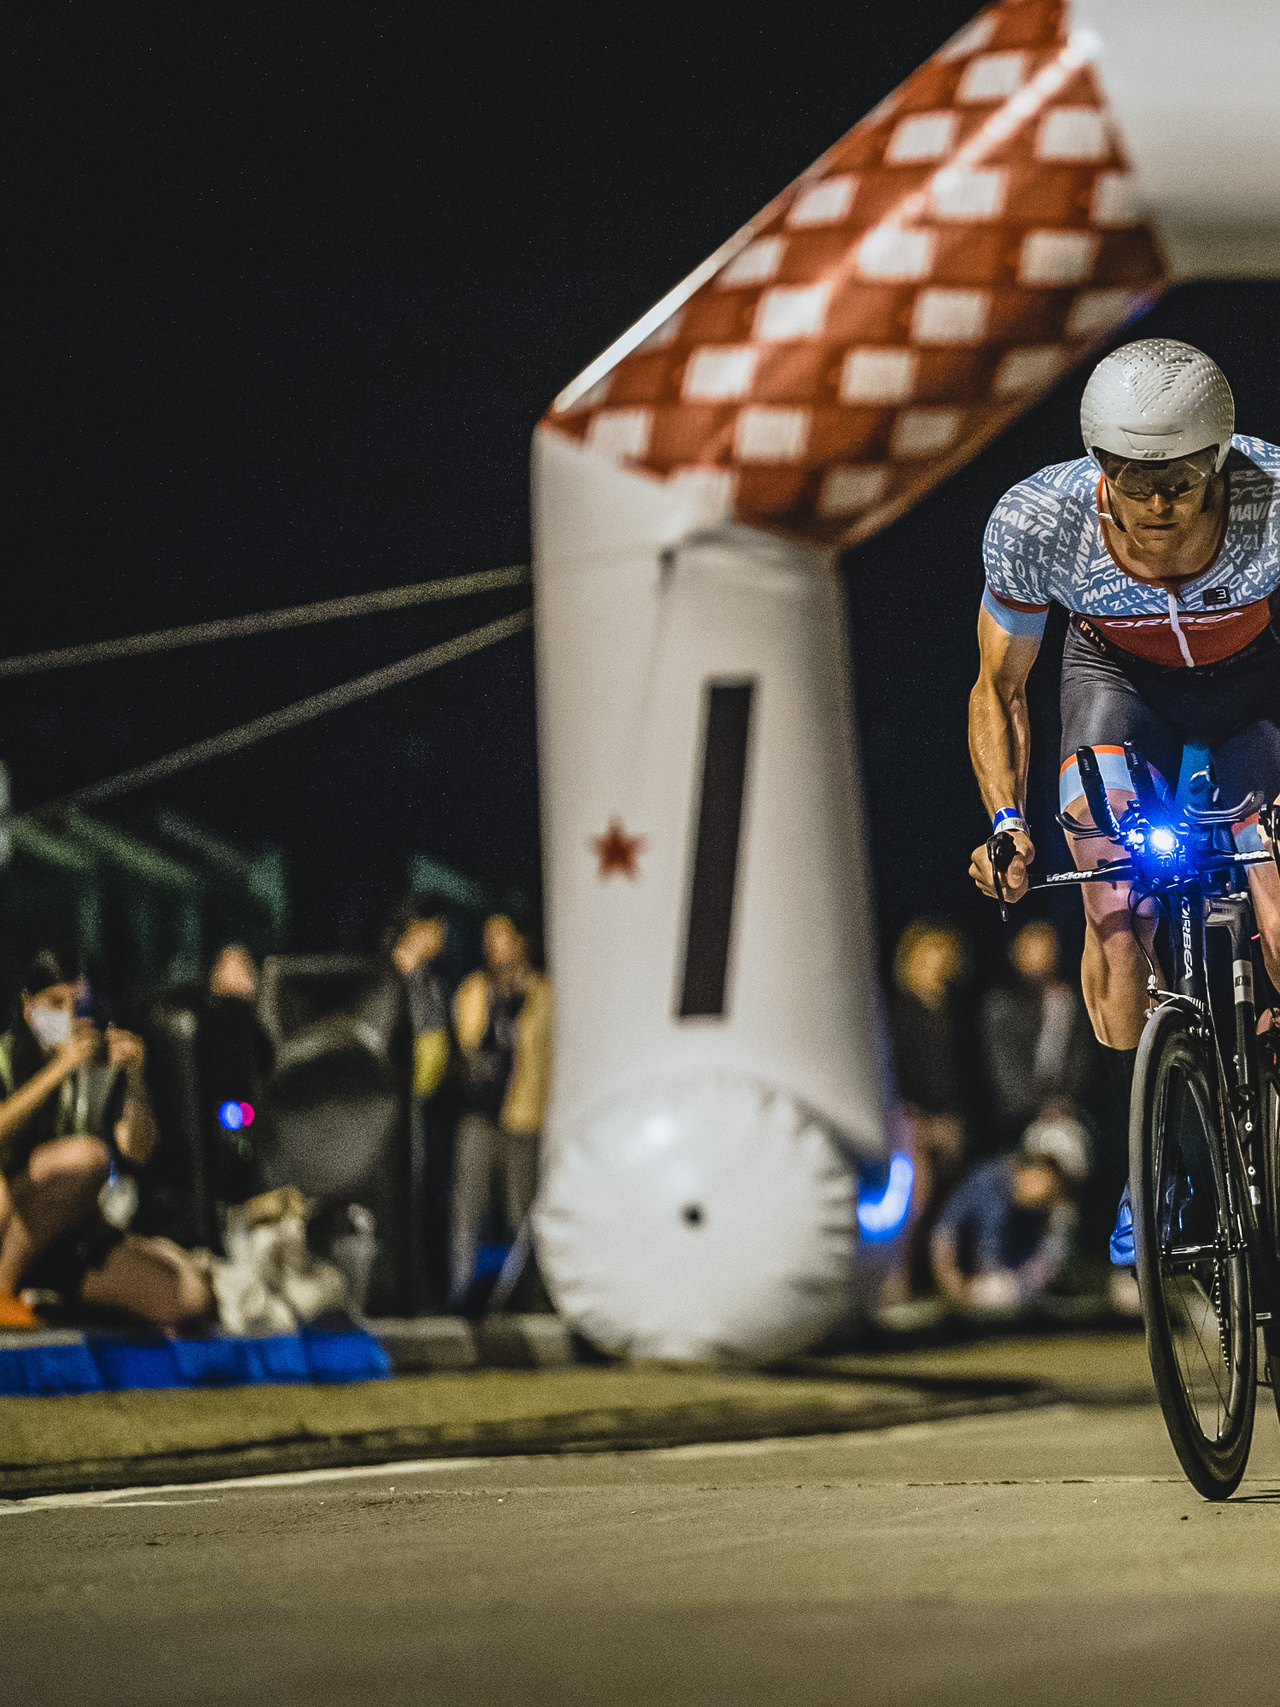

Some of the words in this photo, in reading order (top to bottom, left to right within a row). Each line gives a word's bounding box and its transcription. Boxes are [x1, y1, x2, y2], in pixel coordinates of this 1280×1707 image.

[992, 506, 1054, 545] MAVIC
[1046, 870, 1092, 882] Vision
[1181, 896, 1193, 980] ORBEA
